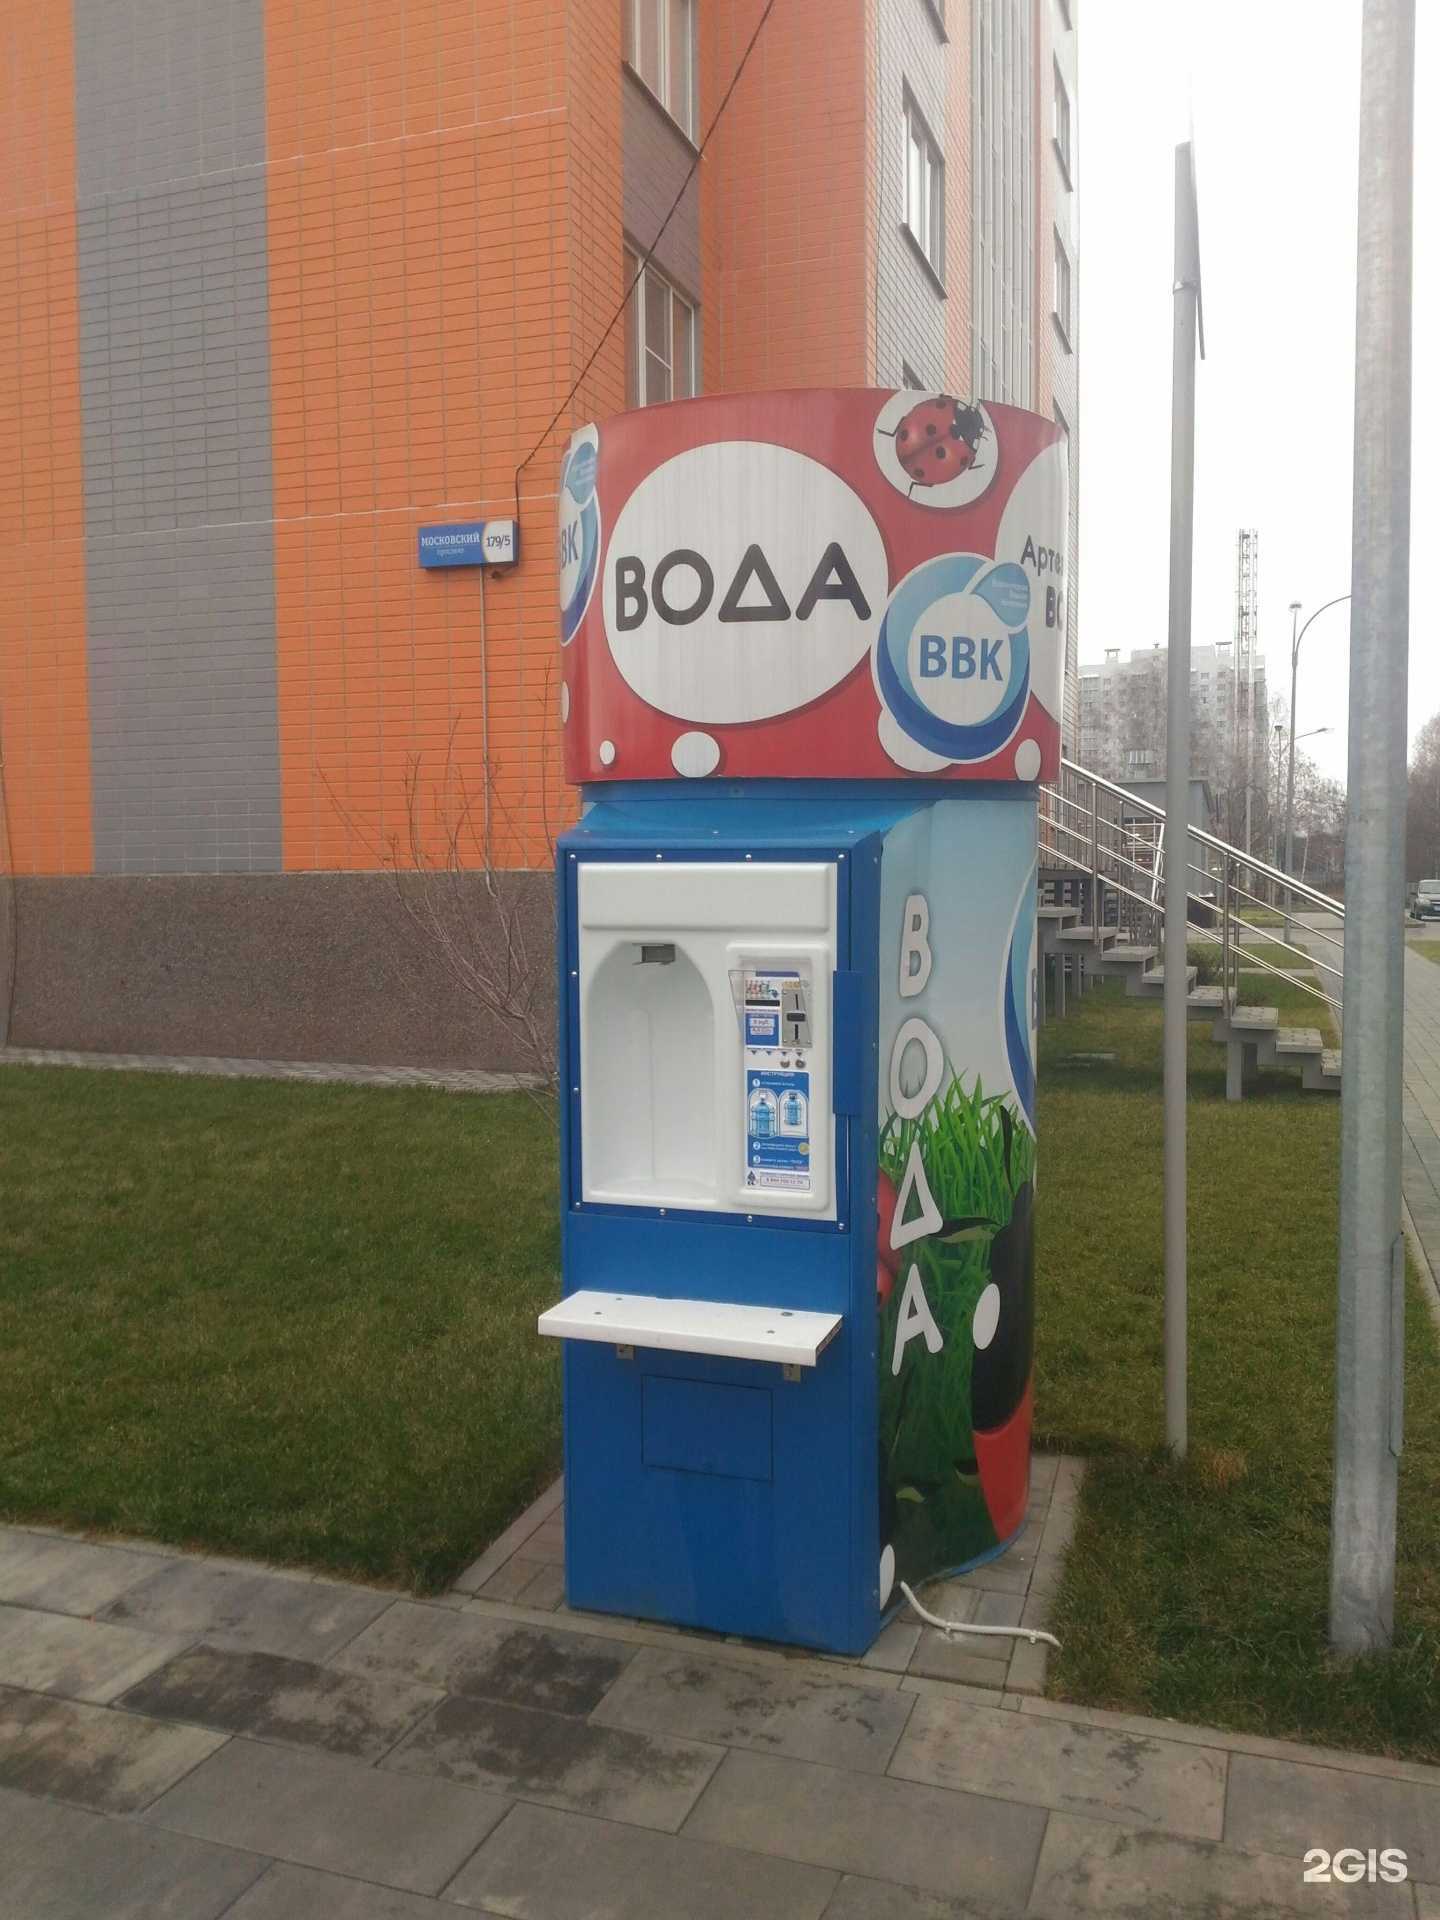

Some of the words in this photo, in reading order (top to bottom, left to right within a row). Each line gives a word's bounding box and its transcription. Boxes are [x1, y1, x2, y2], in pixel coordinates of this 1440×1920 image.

[421, 531, 480, 547] МОСКОВСКИЙ
[486, 535, 511, 549] 179/5
[561, 520, 578, 569] ВК
[1020, 534, 1064, 577] Арте
[615, 541, 872, 633] ВОДА
[919, 634, 1004, 682] ВВК
[889, 894, 945, 1377] ВОДА
